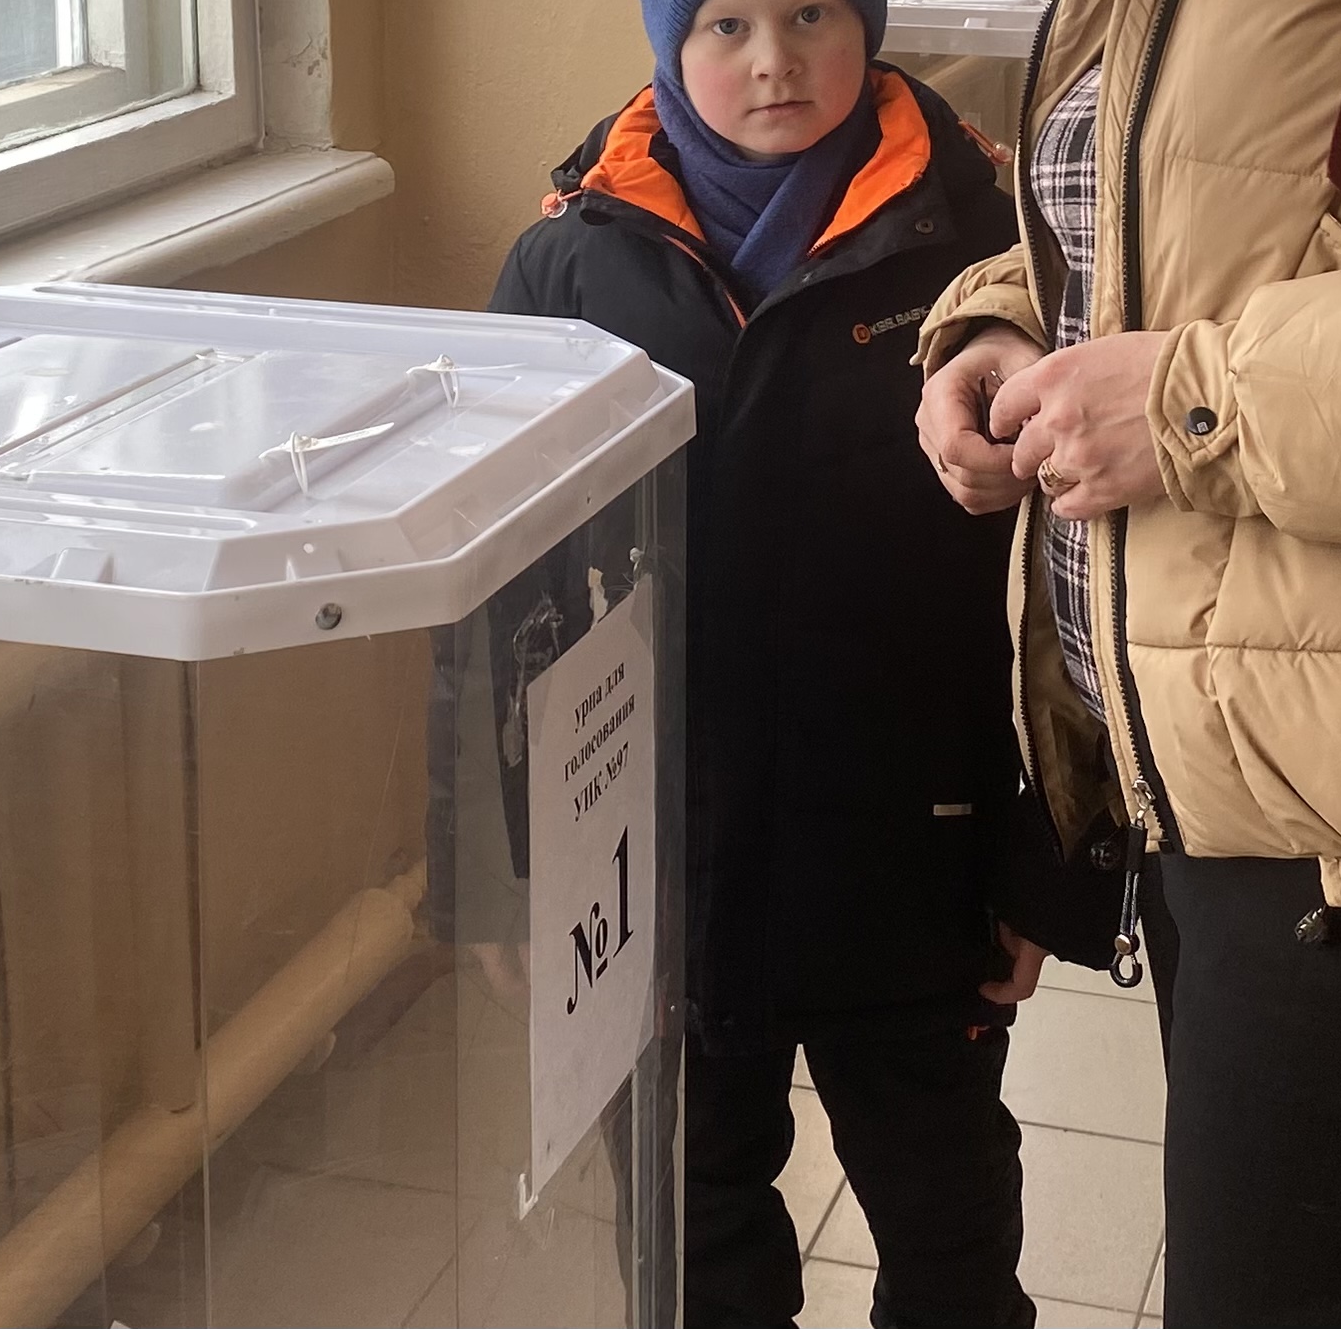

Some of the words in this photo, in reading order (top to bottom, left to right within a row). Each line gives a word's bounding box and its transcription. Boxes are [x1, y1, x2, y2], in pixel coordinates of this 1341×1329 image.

[573, 684, 603, 734] урна
[604, 661, 626, 701] для
[563, 692, 636, 783] голосования
[573, 769, 603, 823] УИК
